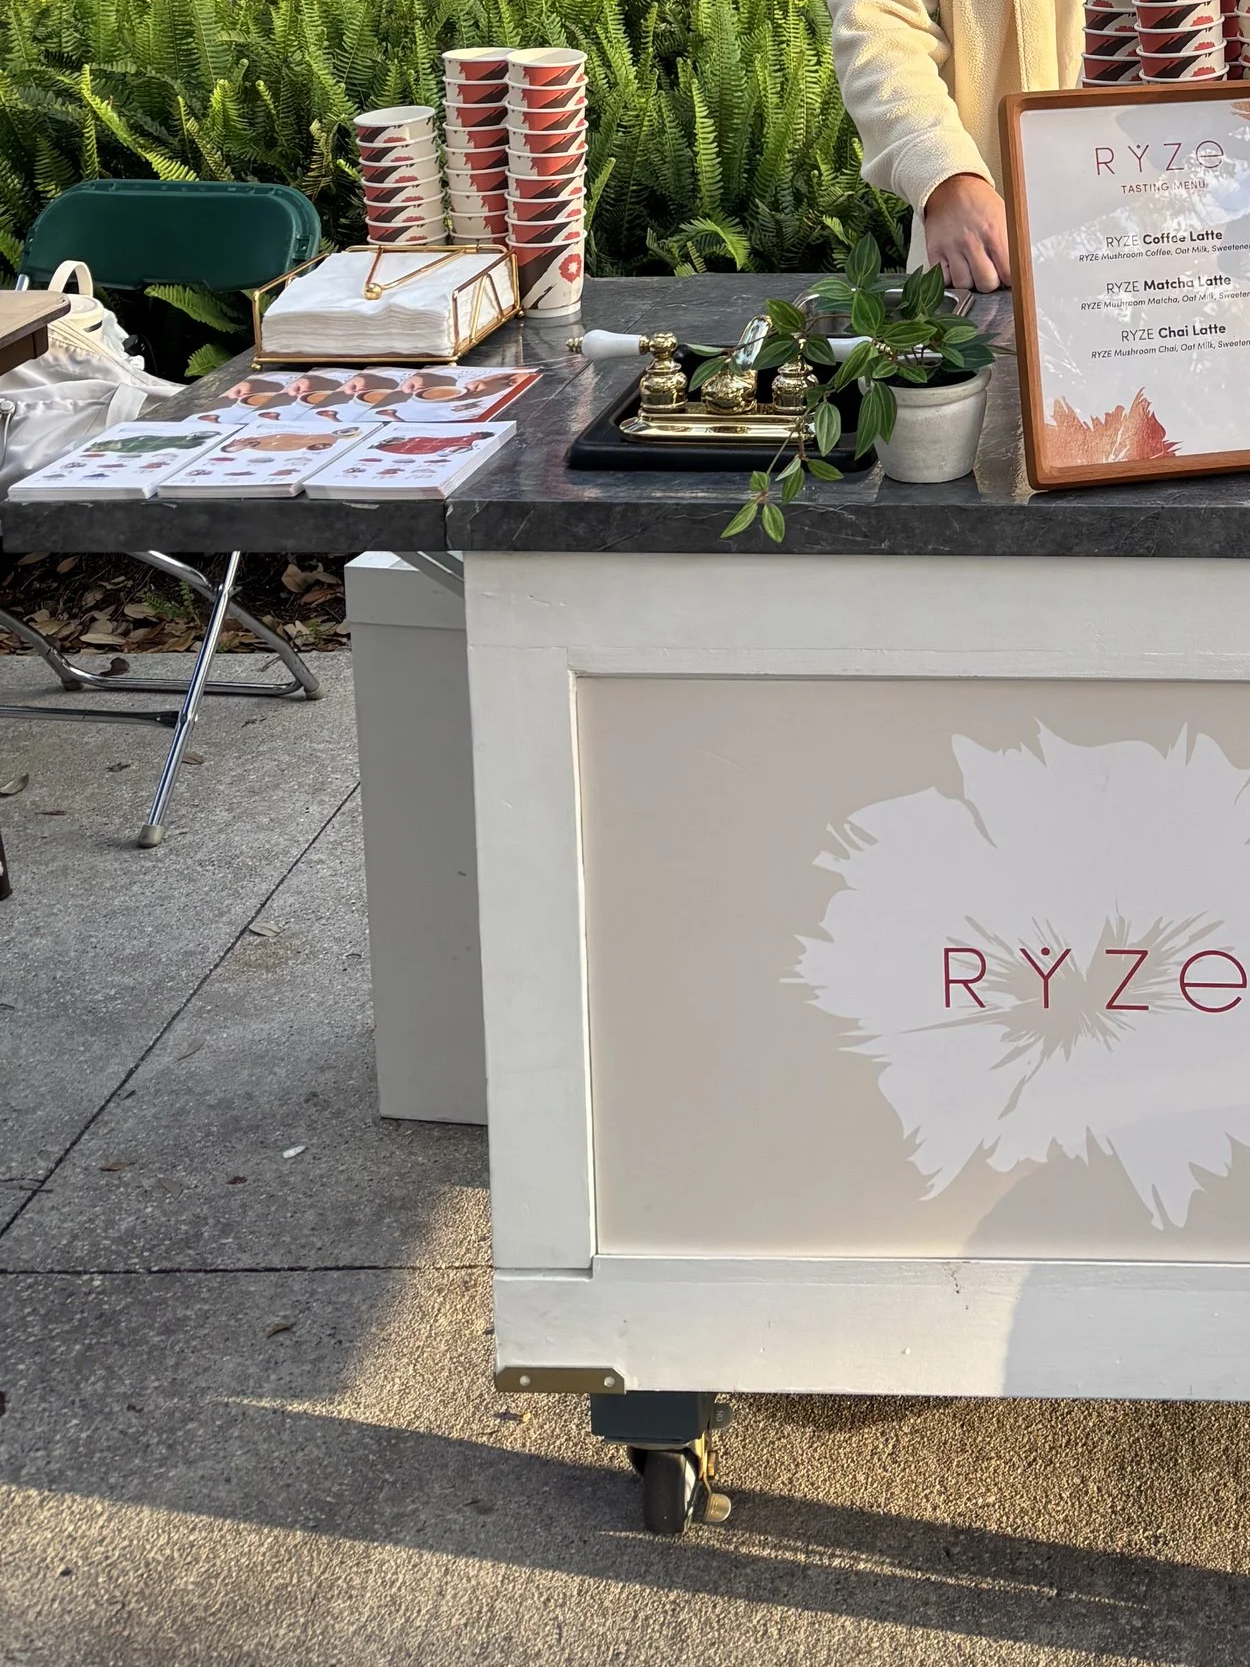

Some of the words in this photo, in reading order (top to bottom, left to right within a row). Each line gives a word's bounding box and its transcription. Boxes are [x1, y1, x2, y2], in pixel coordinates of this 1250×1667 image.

[1121, 182, 1170, 194] TASTING
[1172, 180, 1206, 191] MENU
[1106, 235, 1139, 248] RYZE
[1143, 232, 1186, 245] Coffee
[1189, 230, 1223, 242] Latte
[1079, 253, 1100, 262] RYZE
[1101, 251, 1144, 260] Mushroom
[1175, 247, 1190, 255] Oat
[1106, 281, 1140, 294] RYZE
[1143, 277, 1194, 292] Matcha
[1197, 274, 1231, 287] Latte
[1081, 302, 1102, 311] RYZE
[1182, 294, 1197, 303] Oat
[1121, 328, 1155, 342] RYZE
[1158, 325, 1189, 339] Chai
[1192, 323, 1227, 336] Latte
[1091, 350, 1112, 359] RYZE
[1114, 347, 1156, 357] Mushroom
[1180, 344, 1196, 352] Oat
